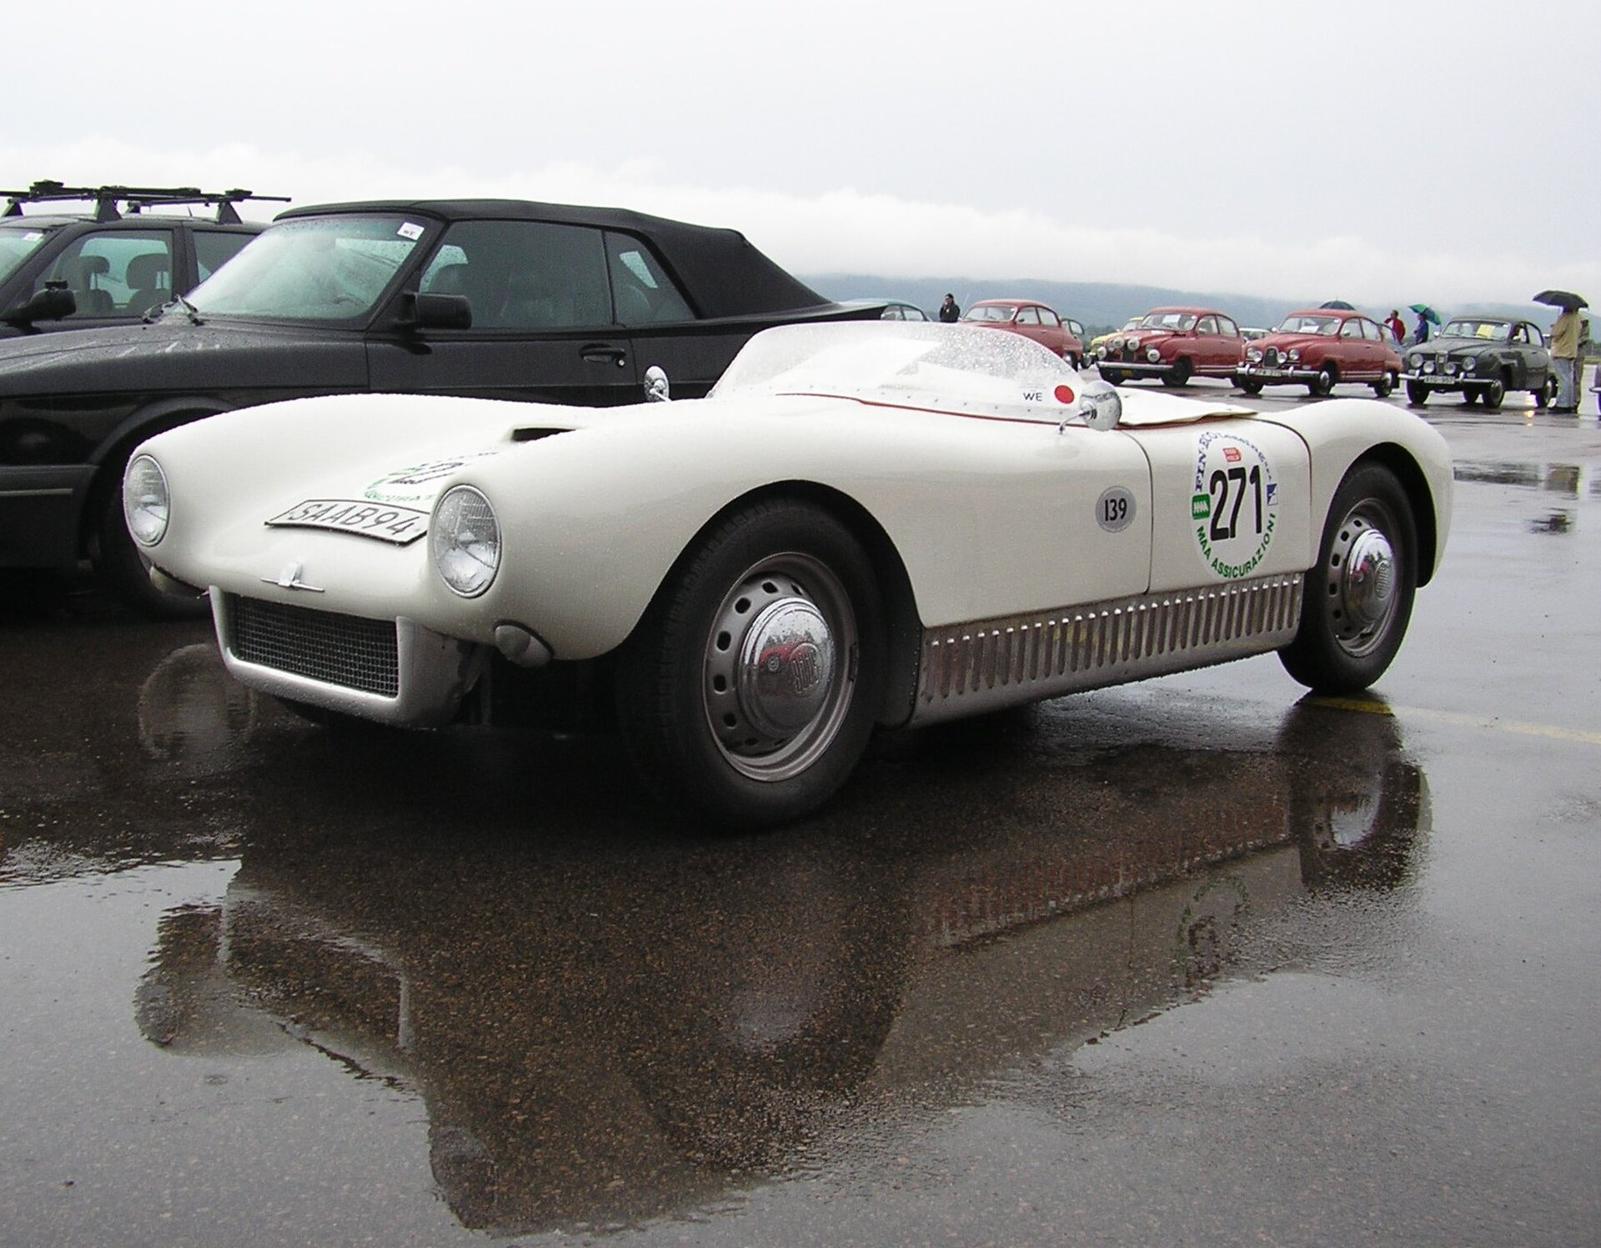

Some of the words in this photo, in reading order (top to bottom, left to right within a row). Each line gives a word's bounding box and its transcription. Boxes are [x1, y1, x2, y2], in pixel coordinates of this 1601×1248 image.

[1023, 392, 1043, 402] WE
[288, 503, 421, 537] SAAB94
[1104, 498, 1128, 522] 139
[1209, 465, 1262, 541] 271
[1211, 513, 1276, 579] ASSICURAZIONI
